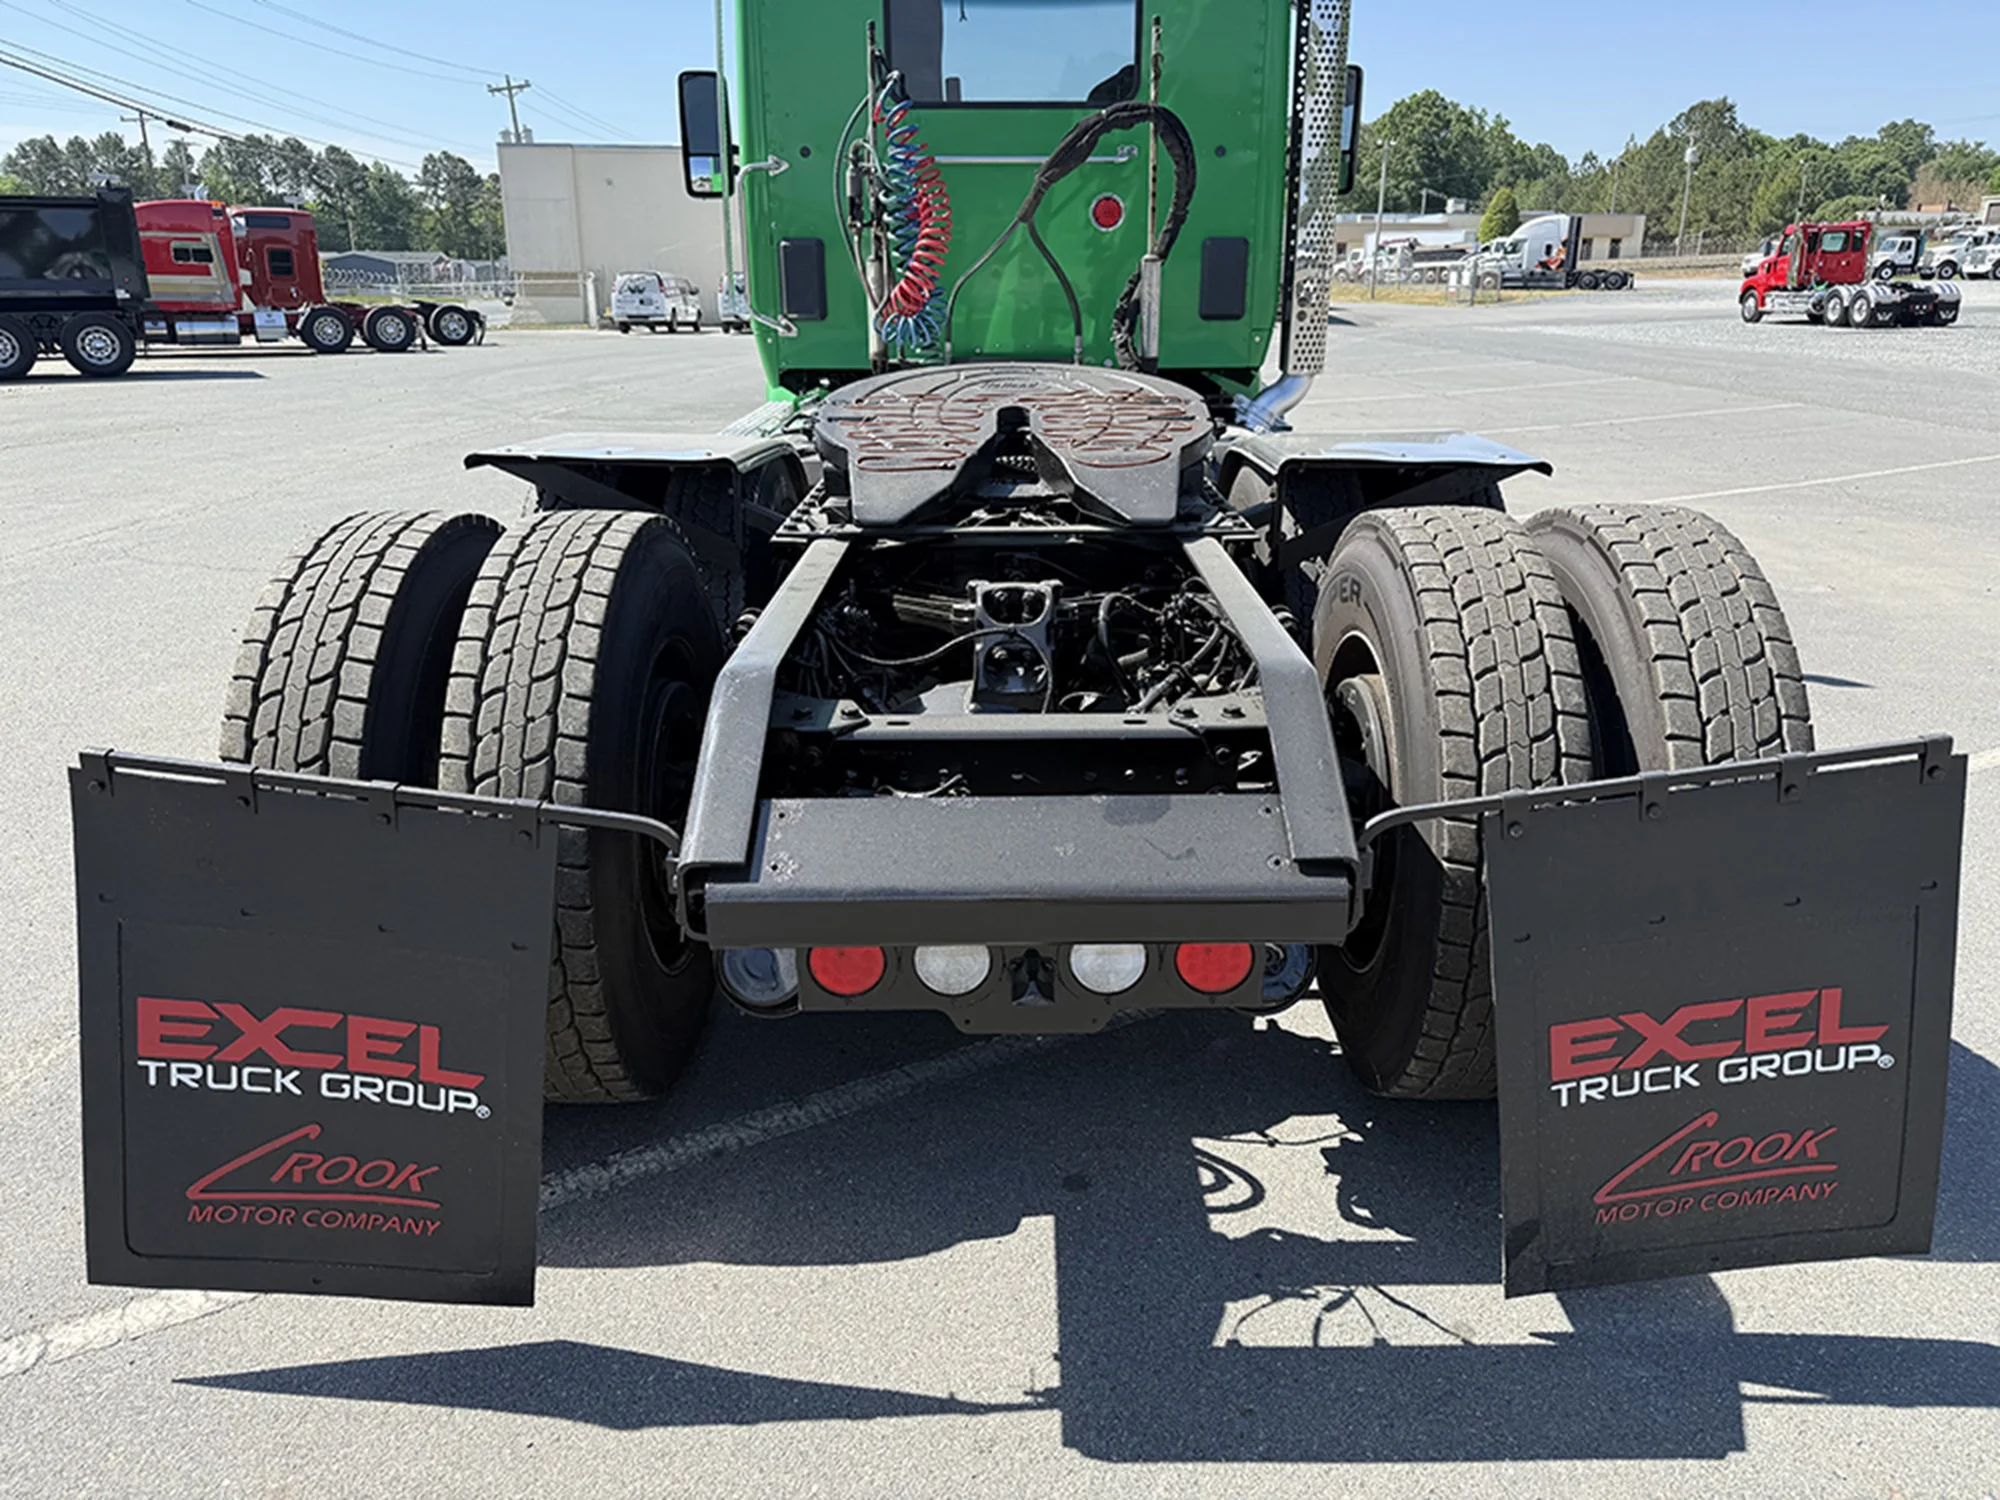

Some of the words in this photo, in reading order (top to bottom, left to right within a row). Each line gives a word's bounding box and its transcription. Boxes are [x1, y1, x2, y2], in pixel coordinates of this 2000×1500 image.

[137, 997, 485, 1089] EXCEL
[1550, 988, 1889, 1081] EXCEL
[137, 1060, 302, 1095] TRUCK
[1550, 1063, 1701, 1108] TRUCK
[187, 1205, 296, 1226] MOTOR
[302, 1210, 442, 1237] COMPANY
[1595, 1195, 1694, 1225] MOTOR
[1700, 1181, 1839, 1213] COMPANY
